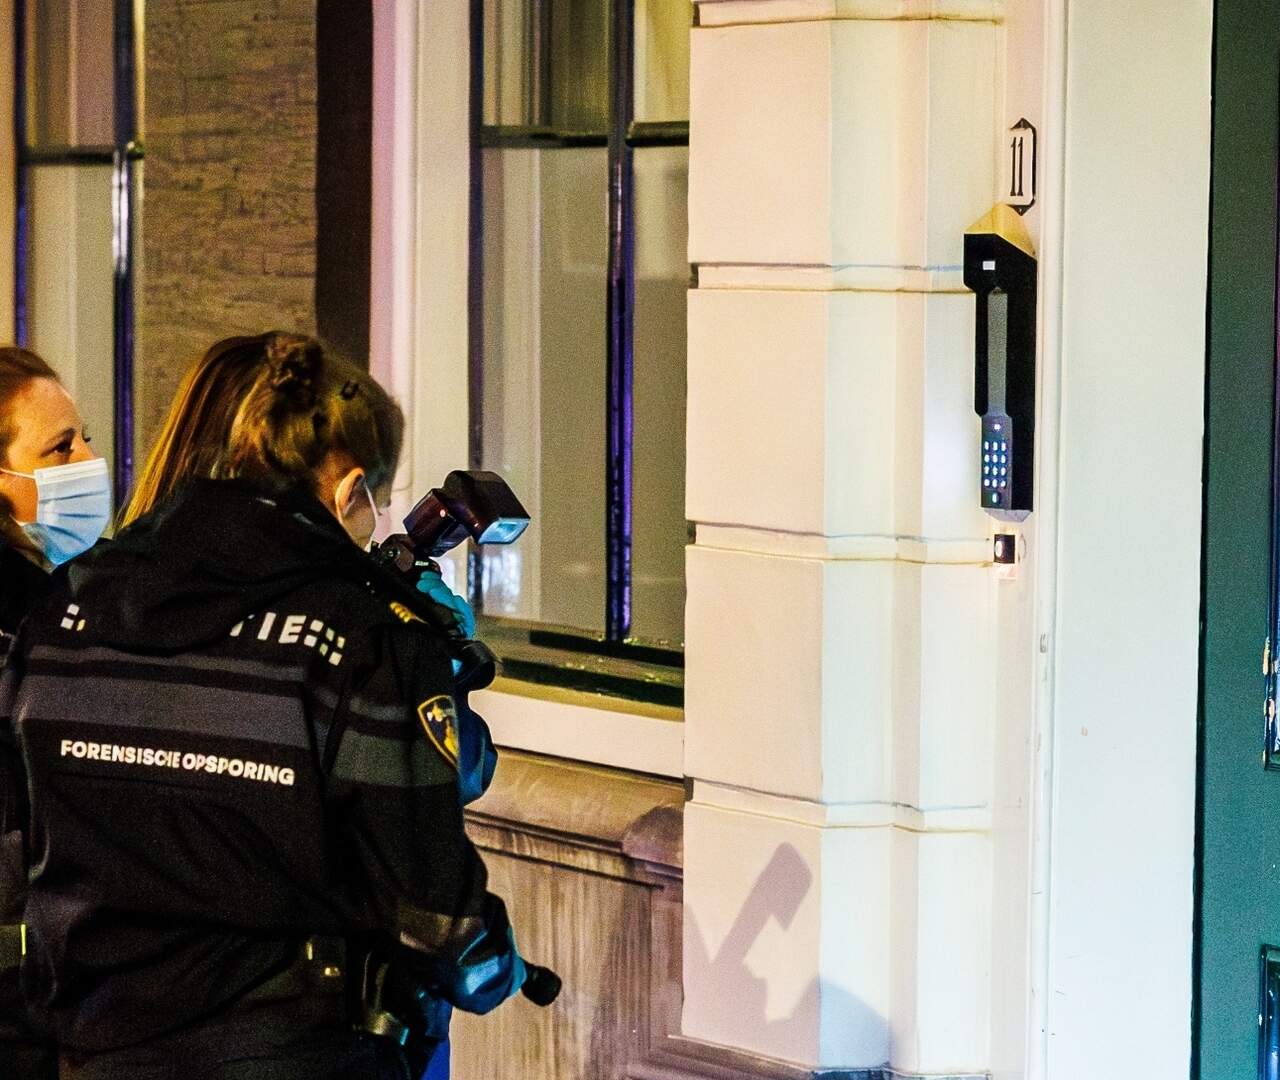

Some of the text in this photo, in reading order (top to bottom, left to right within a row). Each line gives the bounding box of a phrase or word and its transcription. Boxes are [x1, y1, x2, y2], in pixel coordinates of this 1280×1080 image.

[1009, 136, 1024, 197] 11
[60, 739, 296, 786] FORENSISCHE OPSPORING
